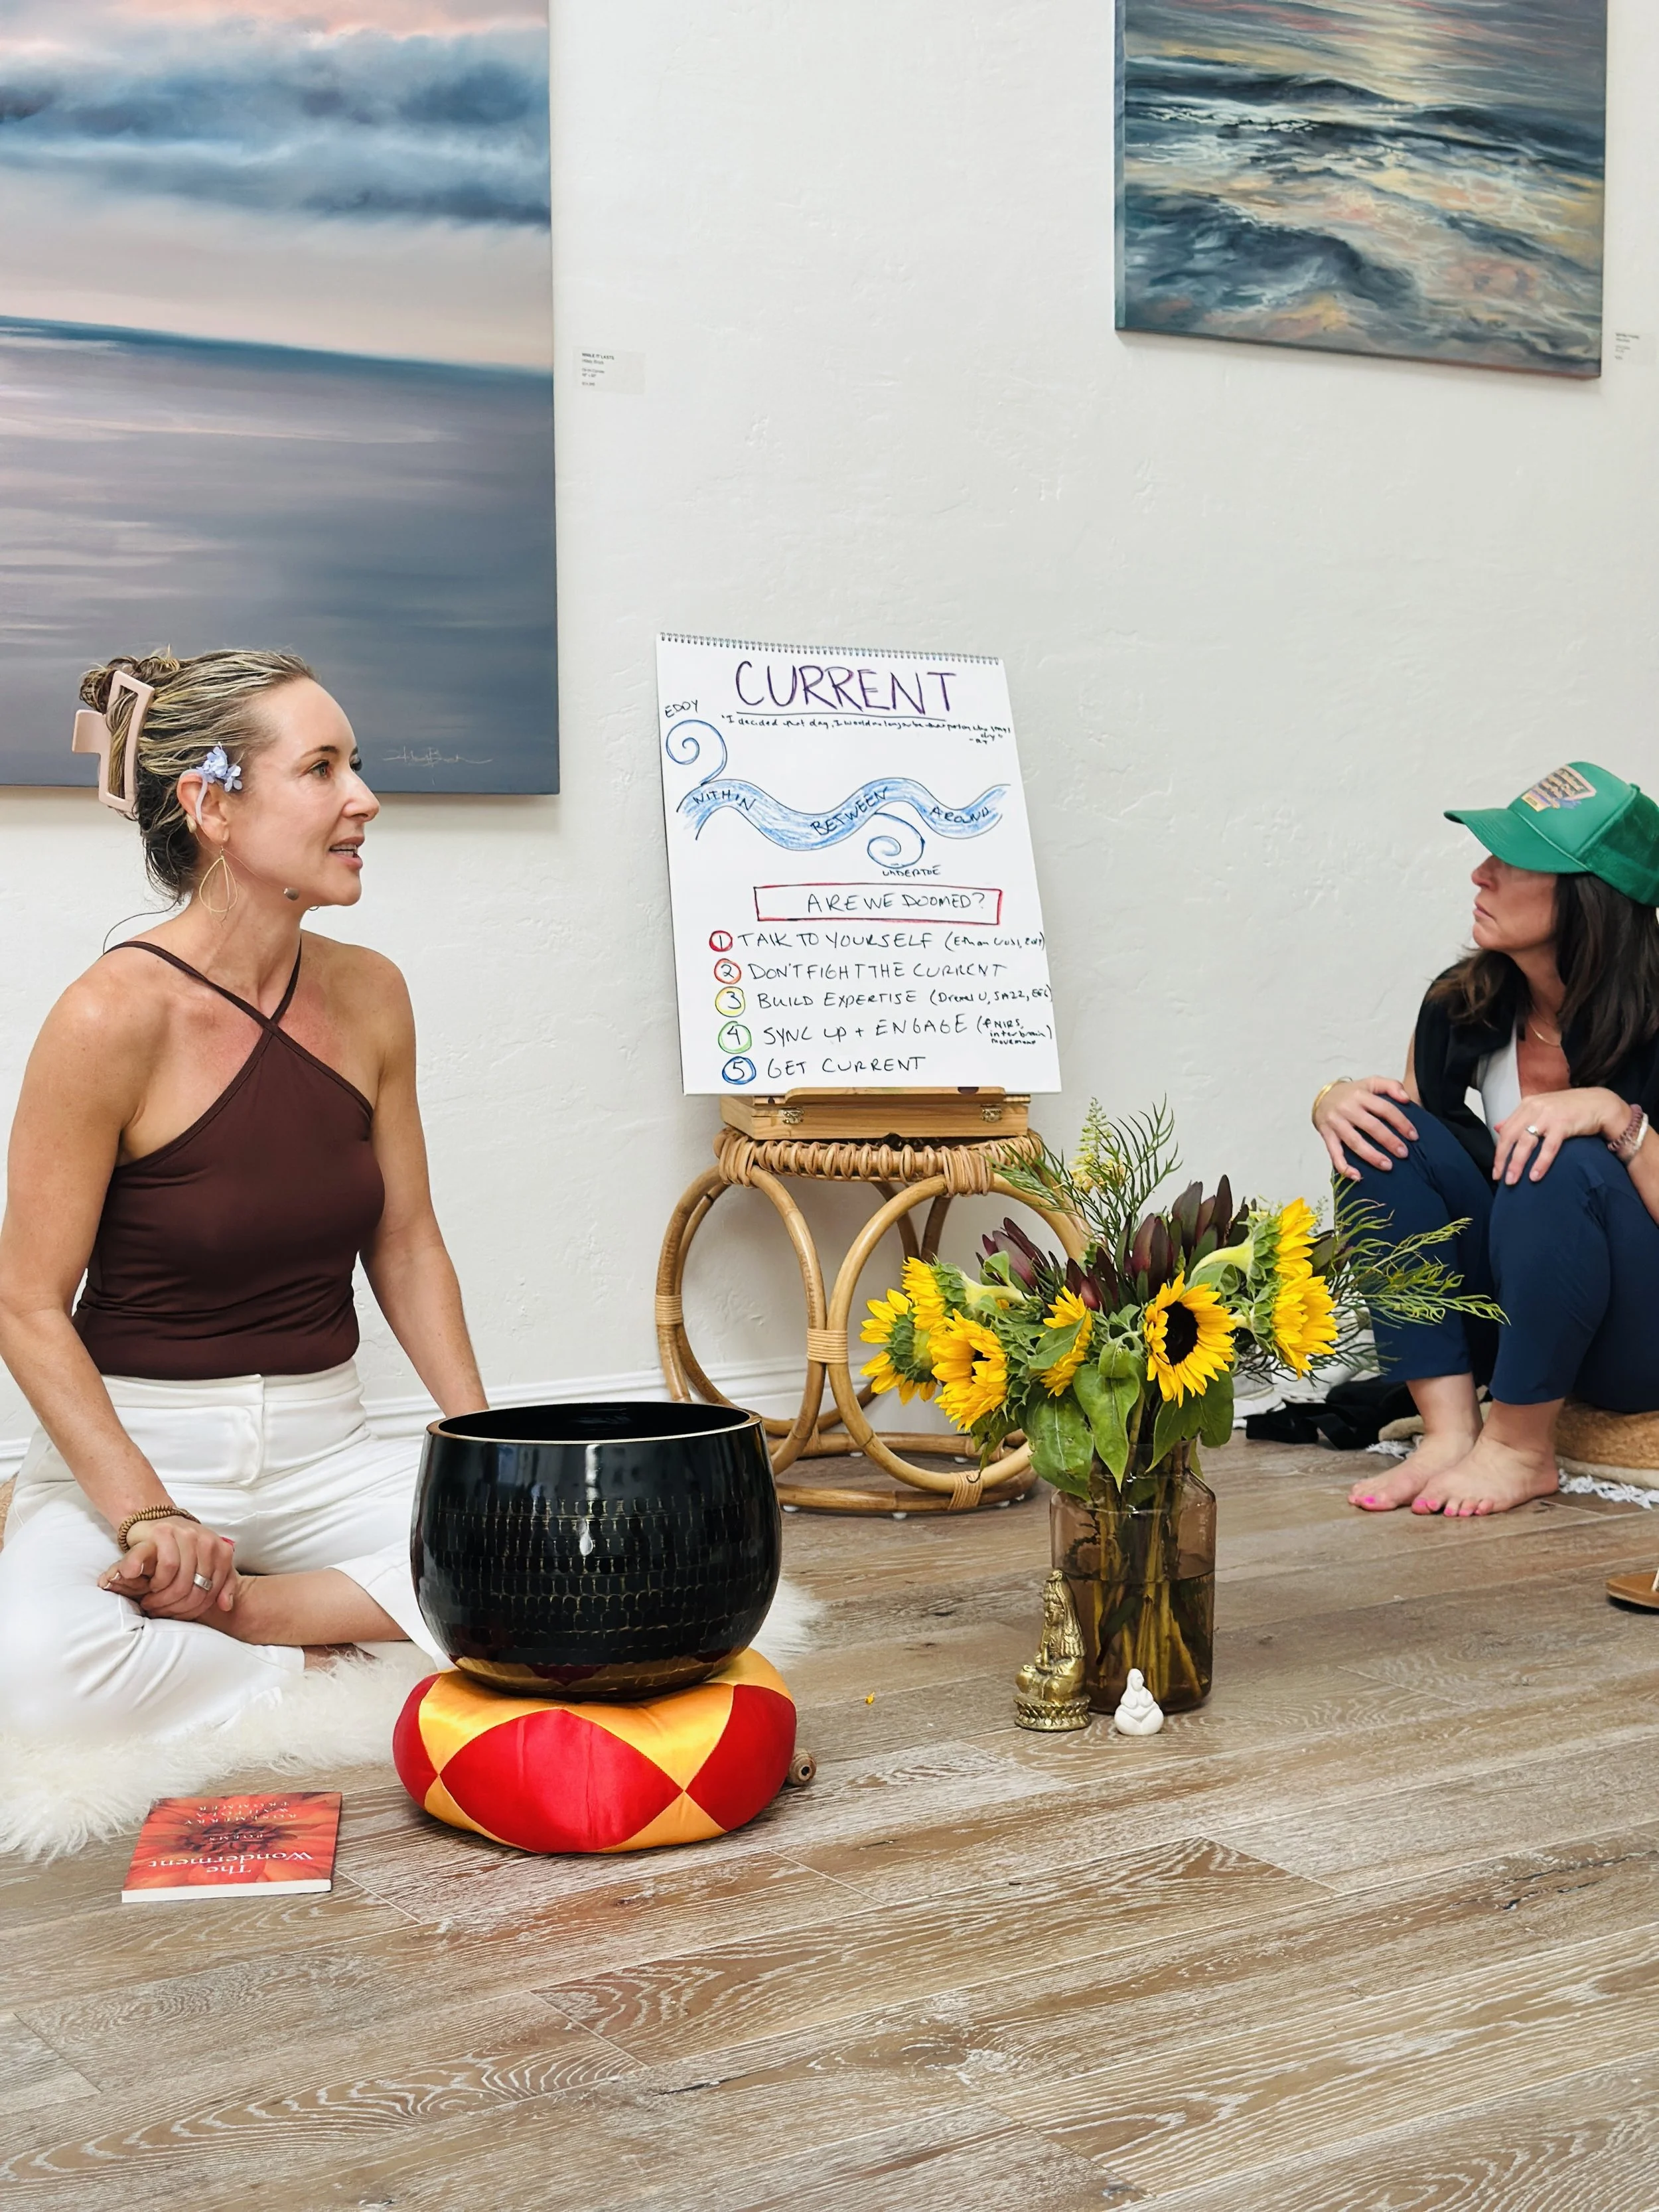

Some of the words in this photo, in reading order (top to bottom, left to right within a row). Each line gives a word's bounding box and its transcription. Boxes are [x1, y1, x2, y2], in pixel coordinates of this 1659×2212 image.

[736, 660, 956, 715] CURRENT
[665, 700, 700, 716] EDDY
[692, 788, 757, 812] WITHIN
[810, 786, 889, 836] BETWEEN
[930, 805, 991, 824] AROUND
[807, 893, 859, 914] ARE
[863, 893, 895, 911] WE
[901, 891, 986, 910] DOOMED?
[738, 932, 793, 948] TALK
[796, 932, 820, 946] TO
[826, 932, 933, 949] YOURSELF
[721, 964, 735, 979] 2
[748, 963, 803, 980] DON'T
[806, 963, 866, 981] FIGHT
[868, 962, 906, 979] THE
[913, 962, 1008, 979] CURRENT
[726, 991, 743, 1009] 3
[757, 992, 814, 1009] BUILD
[824, 990, 917, 1008] EXPERTISE
[727, 1025, 741, 1046] 4
[763, 1025, 814, 1048] SYNC
[824, 1027, 847, 1043] UP
[875, 1013, 968, 1037] ENGAGE
[731, 1061, 745, 1081] 5
[768, 1058, 808, 1079] GET
[822, 1056, 927, 1074] CURRENT
[197, 1801, 289, 1811] TROMMER
[182, 1814, 297, 1825] ROSEMERRY
[148, 1852, 314, 1867] Wonderment
[206, 1864, 251, 1875] The
